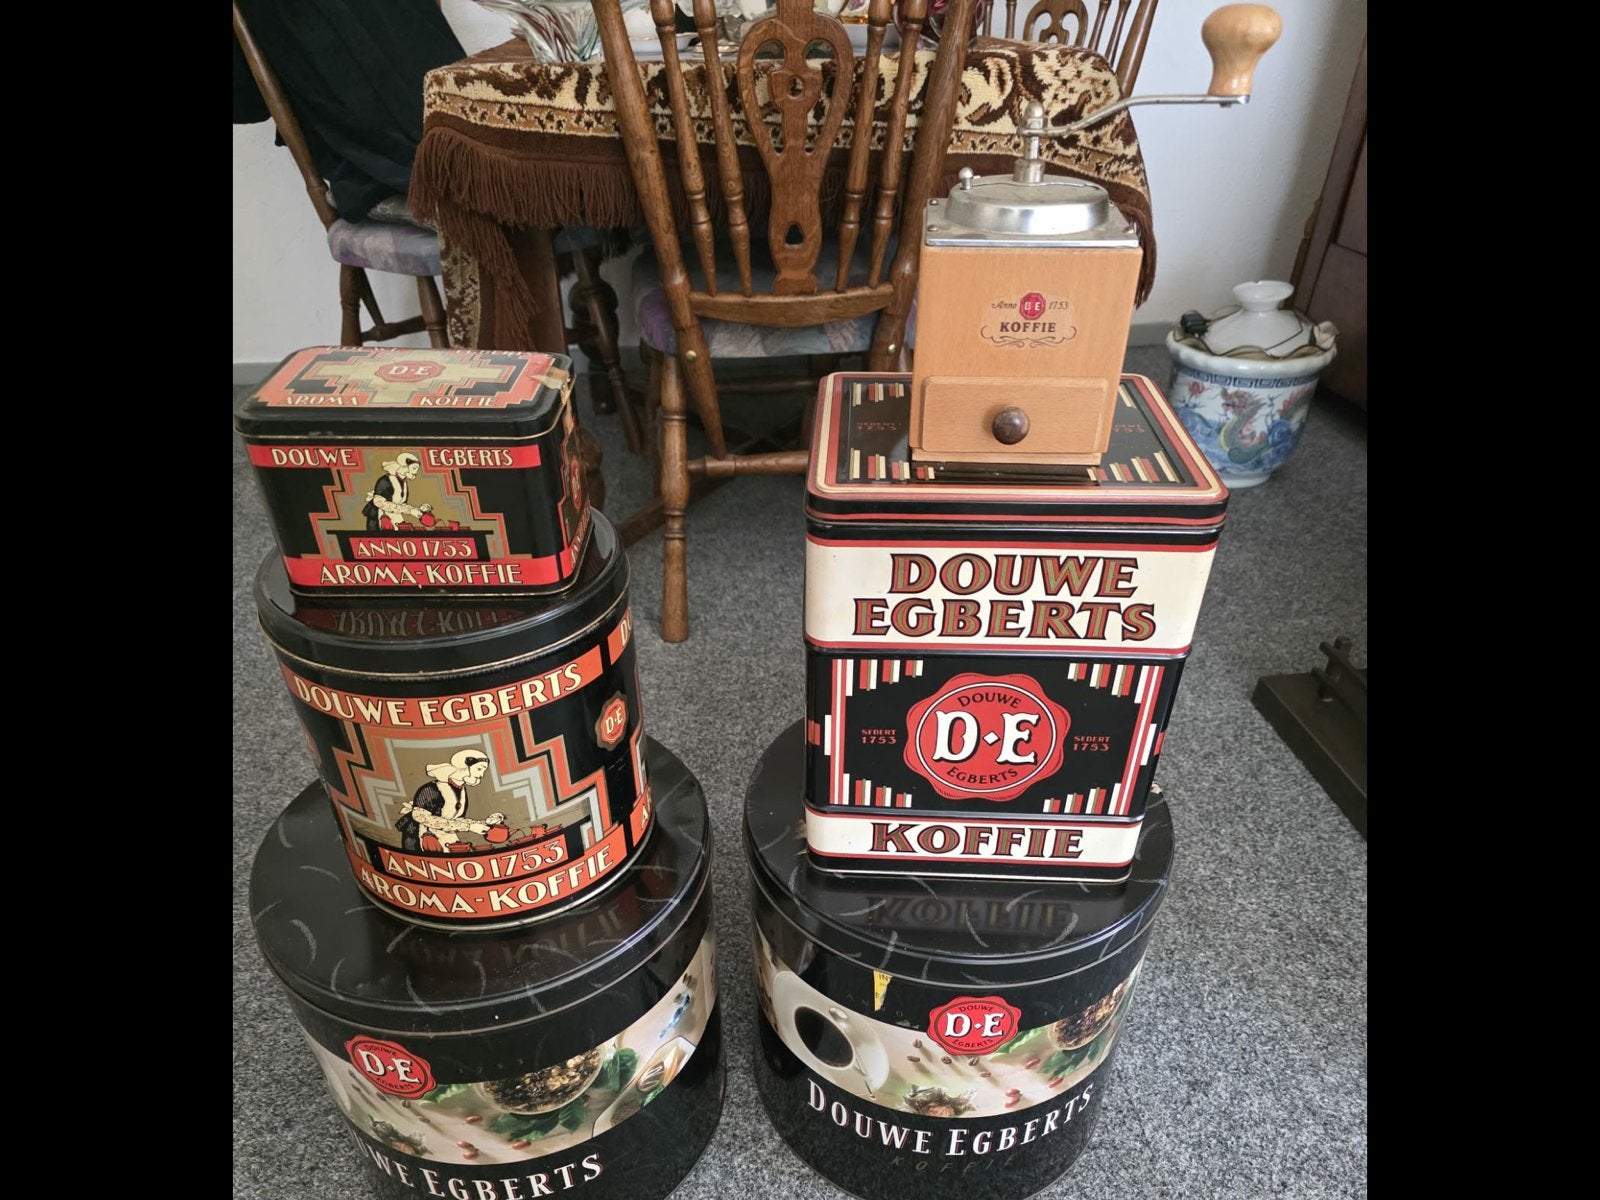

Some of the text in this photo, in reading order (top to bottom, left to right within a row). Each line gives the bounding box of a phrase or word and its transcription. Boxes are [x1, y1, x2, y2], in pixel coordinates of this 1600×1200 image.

[1048, 301, 1069, 310] 1753
[1000, 322, 1056, 333] KOFFIE
[285, 396, 359, 406] AROMA
[271, 448, 514, 467] DOUWE EGBERTS
[356, 540, 473, 558] ANNO 1753
[887, 553, 1140, 598] DOUWE
[852, 598, 1157, 642] EGBERTS
[293, 662, 583, 727] DOUWE EGBERTS
[957, 691, 1022, 709] DOUWE
[861, 736, 897, 745] 1753
[1073, 735, 1111, 743] SEDERT
[1073, 742, 1110, 751] 1753
[946, 765, 1019, 785] EGBERTS
[869, 822, 1084, 859] KOFFIE
[386, 840, 565, 881] ANNO 1753
[958, 1004, 995, 1012] DOUWE
[952, 1038, 994, 1048] EGBERTS
[807, 1078, 1095, 1157] DOUWE EGBERTS
[890, 1153, 1017, 1175] KOFFIE
[418, 1152, 604, 1200] EGBERTS
